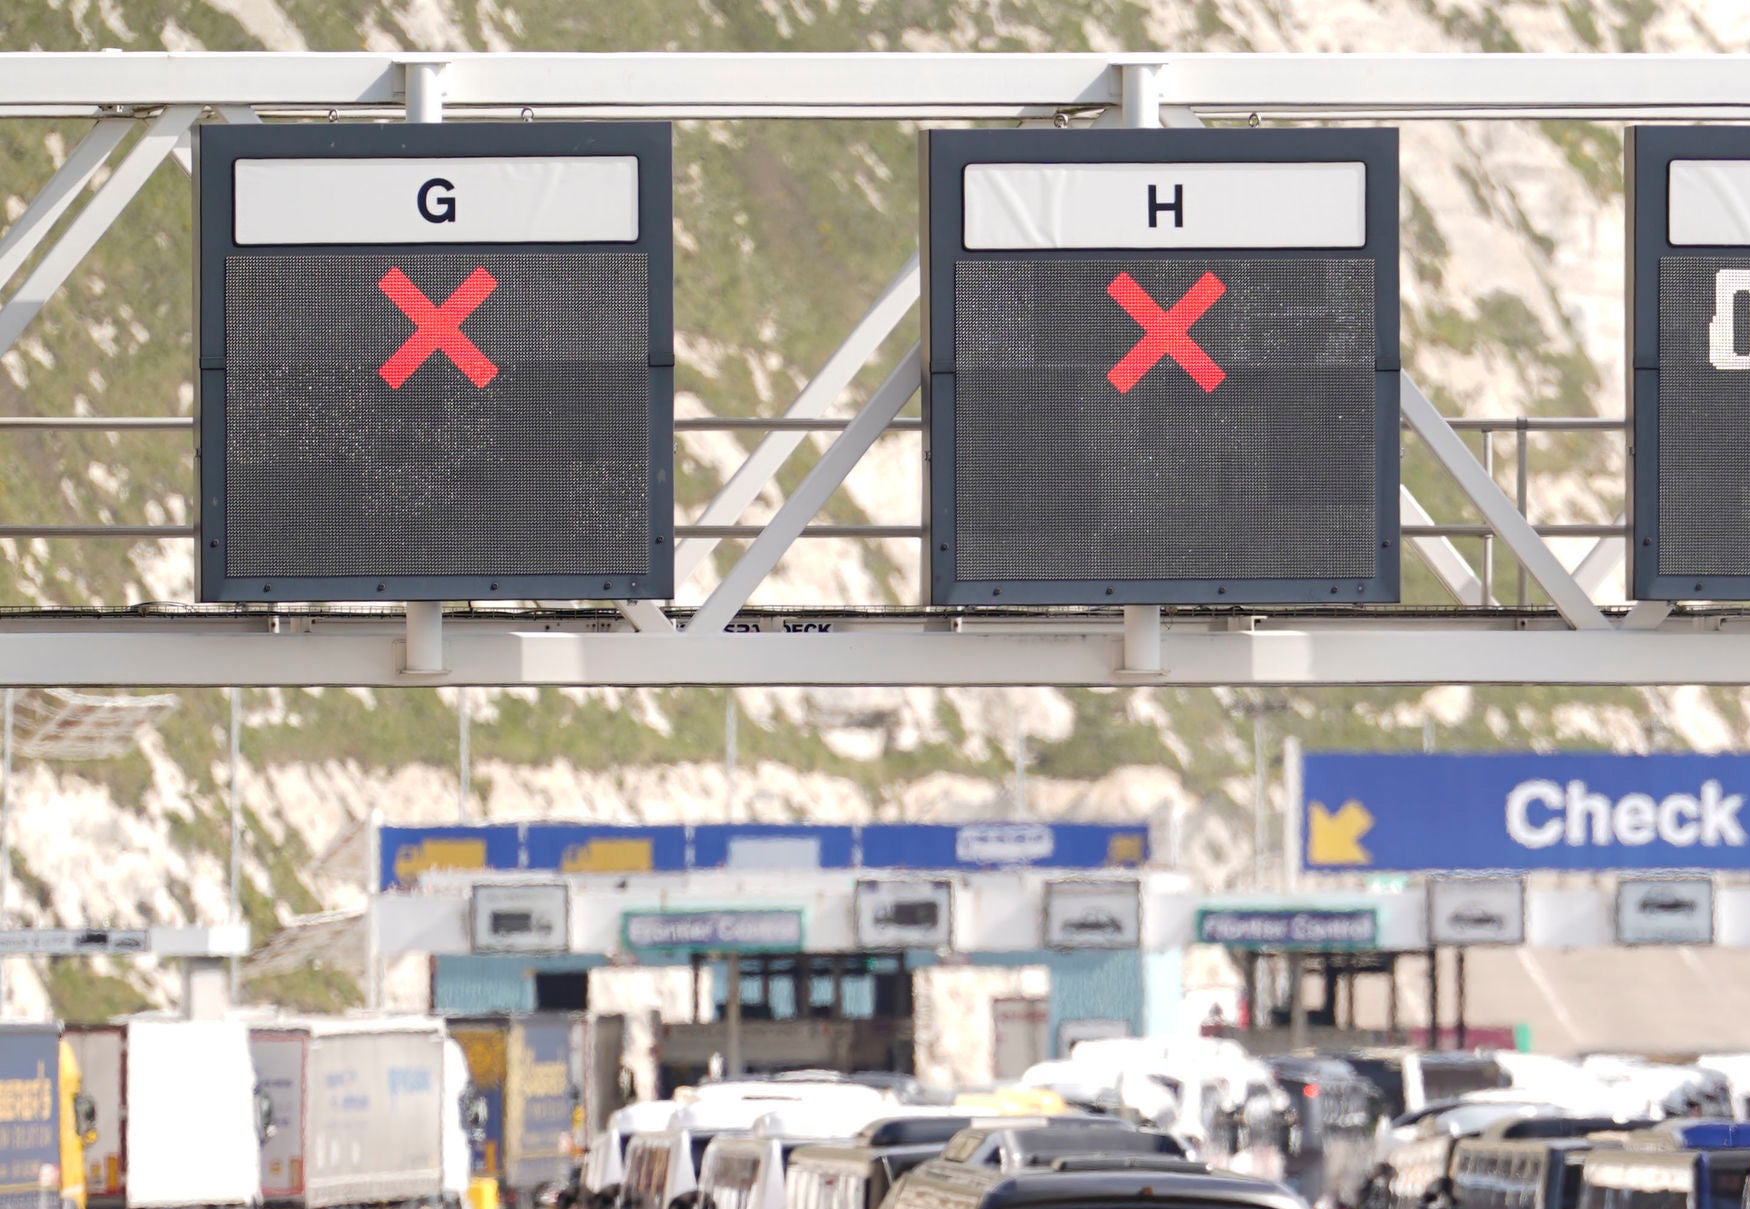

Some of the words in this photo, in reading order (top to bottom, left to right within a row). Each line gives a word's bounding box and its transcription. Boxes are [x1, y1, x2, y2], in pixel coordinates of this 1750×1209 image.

[417, 177, 456, 224] G
[1147, 184, 1184, 228] H
[1505, 780, 1748, 849] Check
